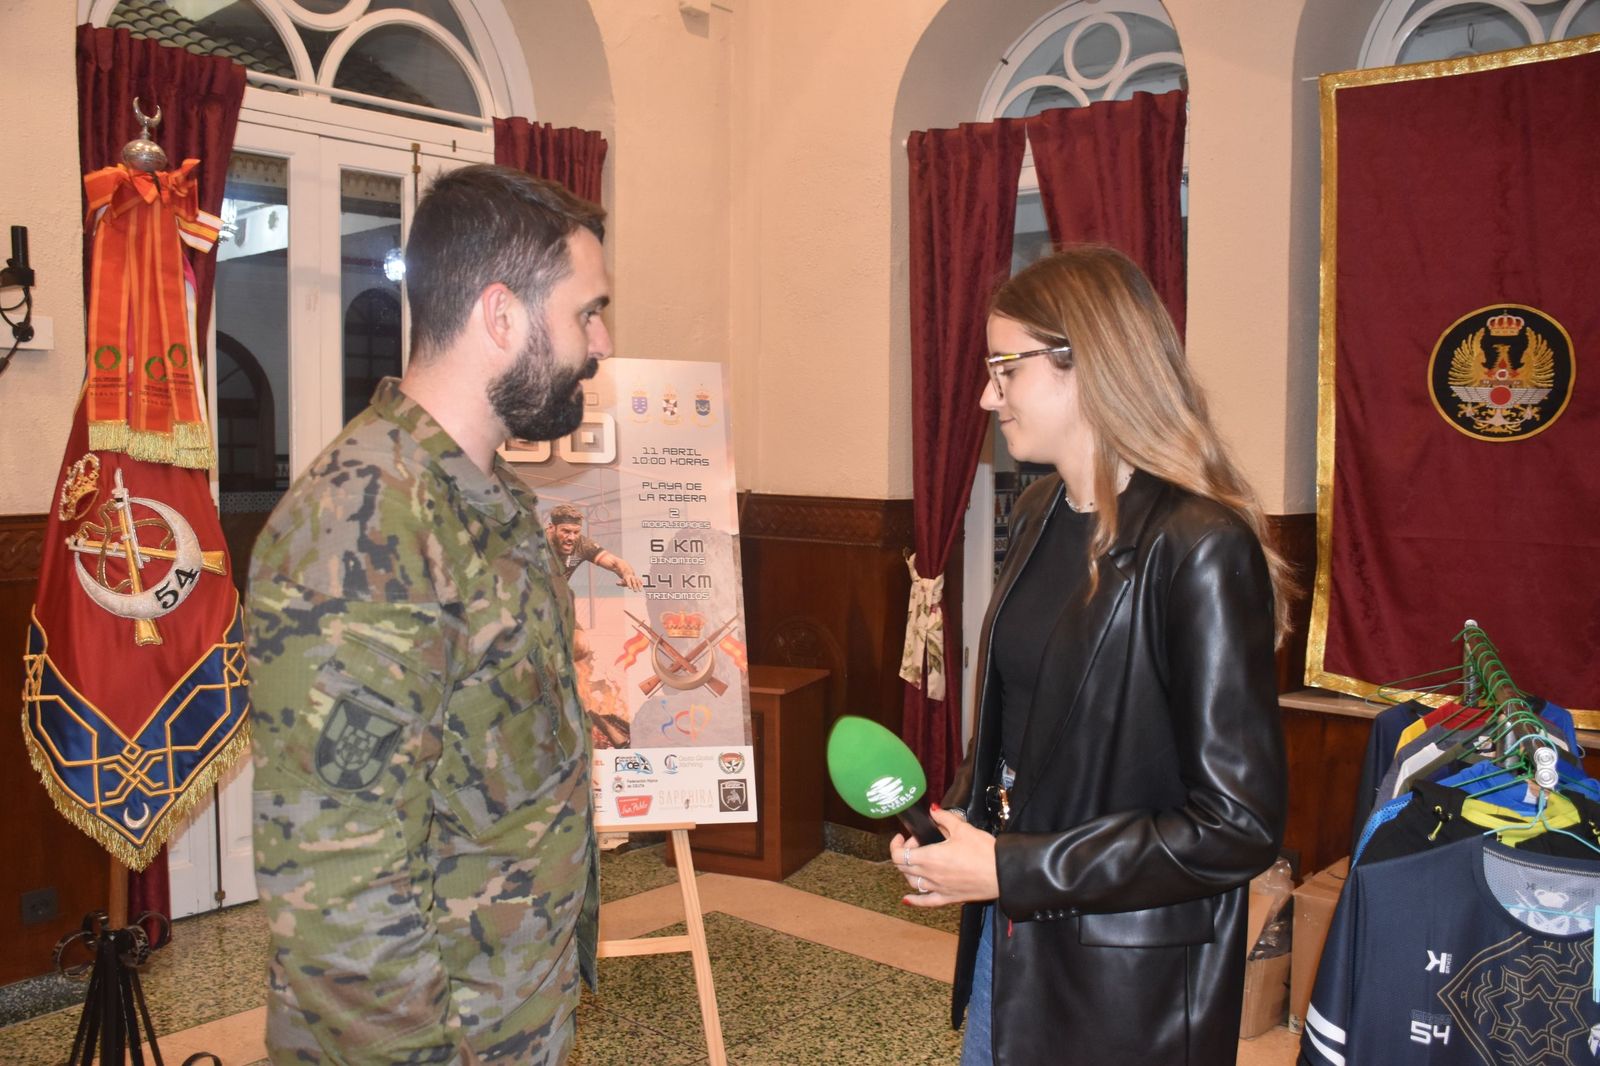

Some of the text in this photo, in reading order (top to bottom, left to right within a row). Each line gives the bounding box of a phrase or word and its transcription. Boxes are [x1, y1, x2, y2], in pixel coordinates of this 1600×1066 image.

[642, 447, 702, 456] 11 ABRIL
[632, 456, 710, 466] 10:00 HORAS
[642, 482, 702, 490] PLAYA DE
[638, 494, 707, 502] LA RIBERA
[669, 507, 681, 519] 2
[642, 520, 711, 529] MODALIDADES
[650, 539, 704, 552] 6 KM
[650, 556, 706, 565] BINOMIOS
[642, 574, 712, 588] 14 KM
[154, 568, 200, 609] 54
[646, 592, 710, 601] TRINOMIOS
[1410, 1020, 1450, 1045] 54
